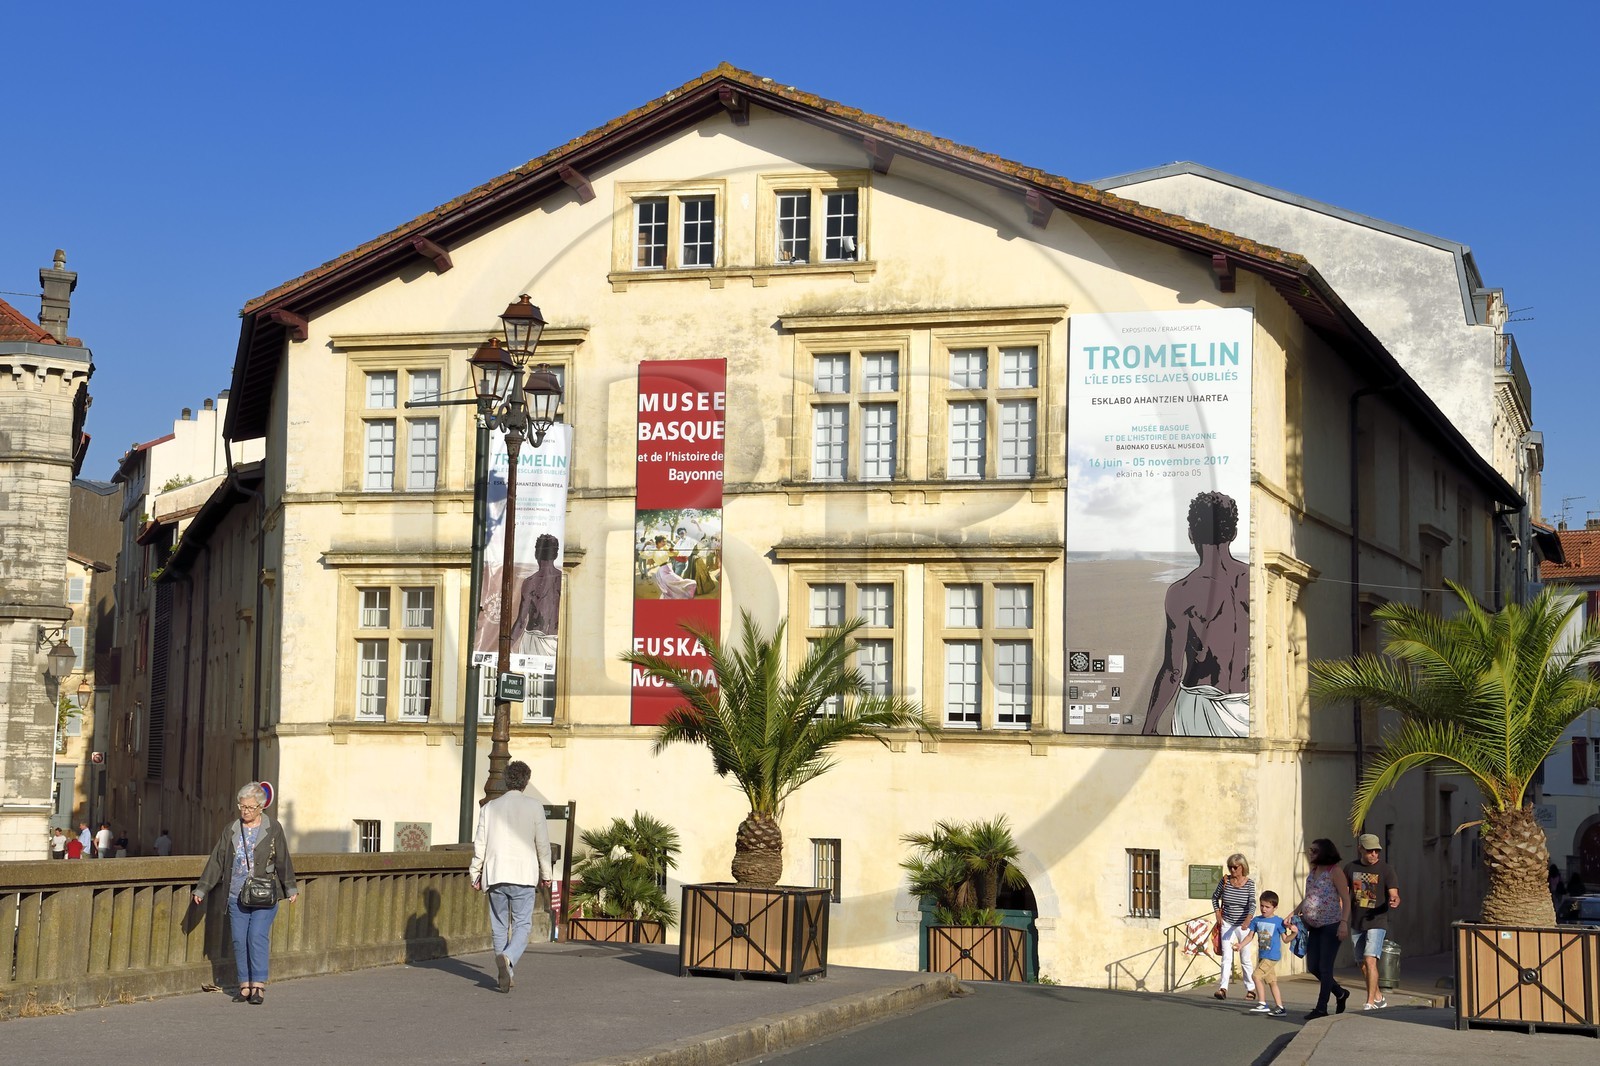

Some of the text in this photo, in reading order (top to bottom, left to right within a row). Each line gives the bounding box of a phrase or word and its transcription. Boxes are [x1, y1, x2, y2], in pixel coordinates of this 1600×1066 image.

[1083, 342, 1239, 370] TROMELIN
[1112, 375, 1132, 384] DES
[1136, 374, 1188, 384] ESCLAVES
[1192, 370, 1238, 382] OUBLIÉS
[639, 392, 725, 412] MUSEE
[1092, 394, 1228, 405] ESKLABO AHANTZIEN UHARTEA
[638, 420, 724, 442] BASQUE
[494, 454, 566, 468] TRMELIN
[638, 454, 648, 462] et
[650, 452, 662, 462] de
[712, 451, 724, 460] de
[1089, 458, 1100, 467] 16
[1103, 458, 1122, 469] juin
[1133, 458, 1144, 466] 05
[1148, 456, 1200, 466] novembre
[1204, 456, 1229, 466] 2017
[669, 468, 723, 484] Bayonne
[634, 638, 713, 656] EUSKA
